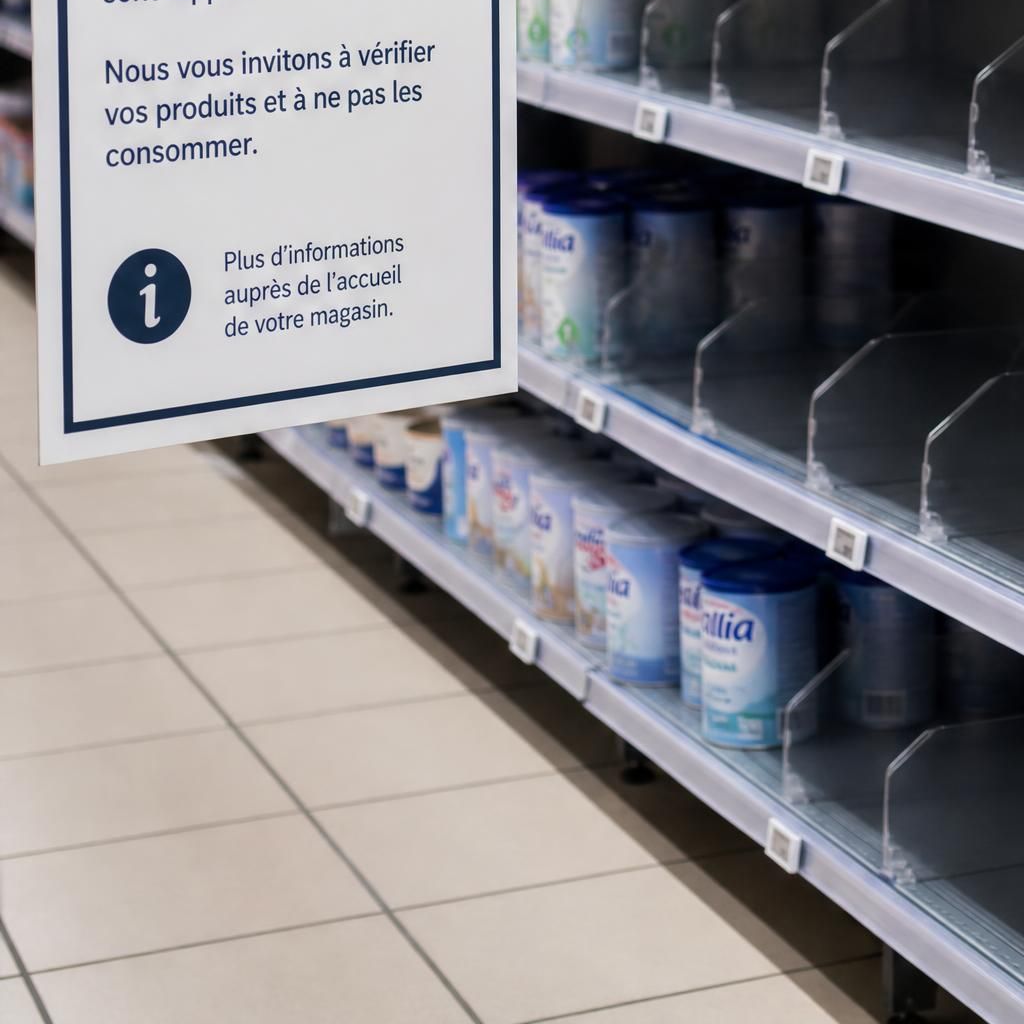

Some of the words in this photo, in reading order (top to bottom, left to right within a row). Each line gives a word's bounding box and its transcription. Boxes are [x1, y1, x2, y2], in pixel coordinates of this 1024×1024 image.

[105, 58, 170, 85] Nous
[176, 57, 234, 79] vous
[241, 49, 333, 75] invitons
[338, 43, 352, 68] à
[358, 39, 436, 67] vérifier
[104, 105, 148, 126] vos
[156, 91, 257, 129] produits
[263, 89, 287, 113] et
[293, 87, 306, 111] à
[314, 89, 341, 109] ne
[347, 84, 386, 113] pas
[393, 79, 423, 103] les
[105, 137, 258, 167] consommer.
[224, 250, 265, 272] Plus
[271, 236, 405, 267] d’informations
[224, 278, 292, 308] auprès
[297, 274, 321, 297] de
[327, 263, 402, 293] l’accueil
[224, 316, 249, 338] de
[255, 311, 304, 335] votre
[310, 298, 393, 328] magasin.
